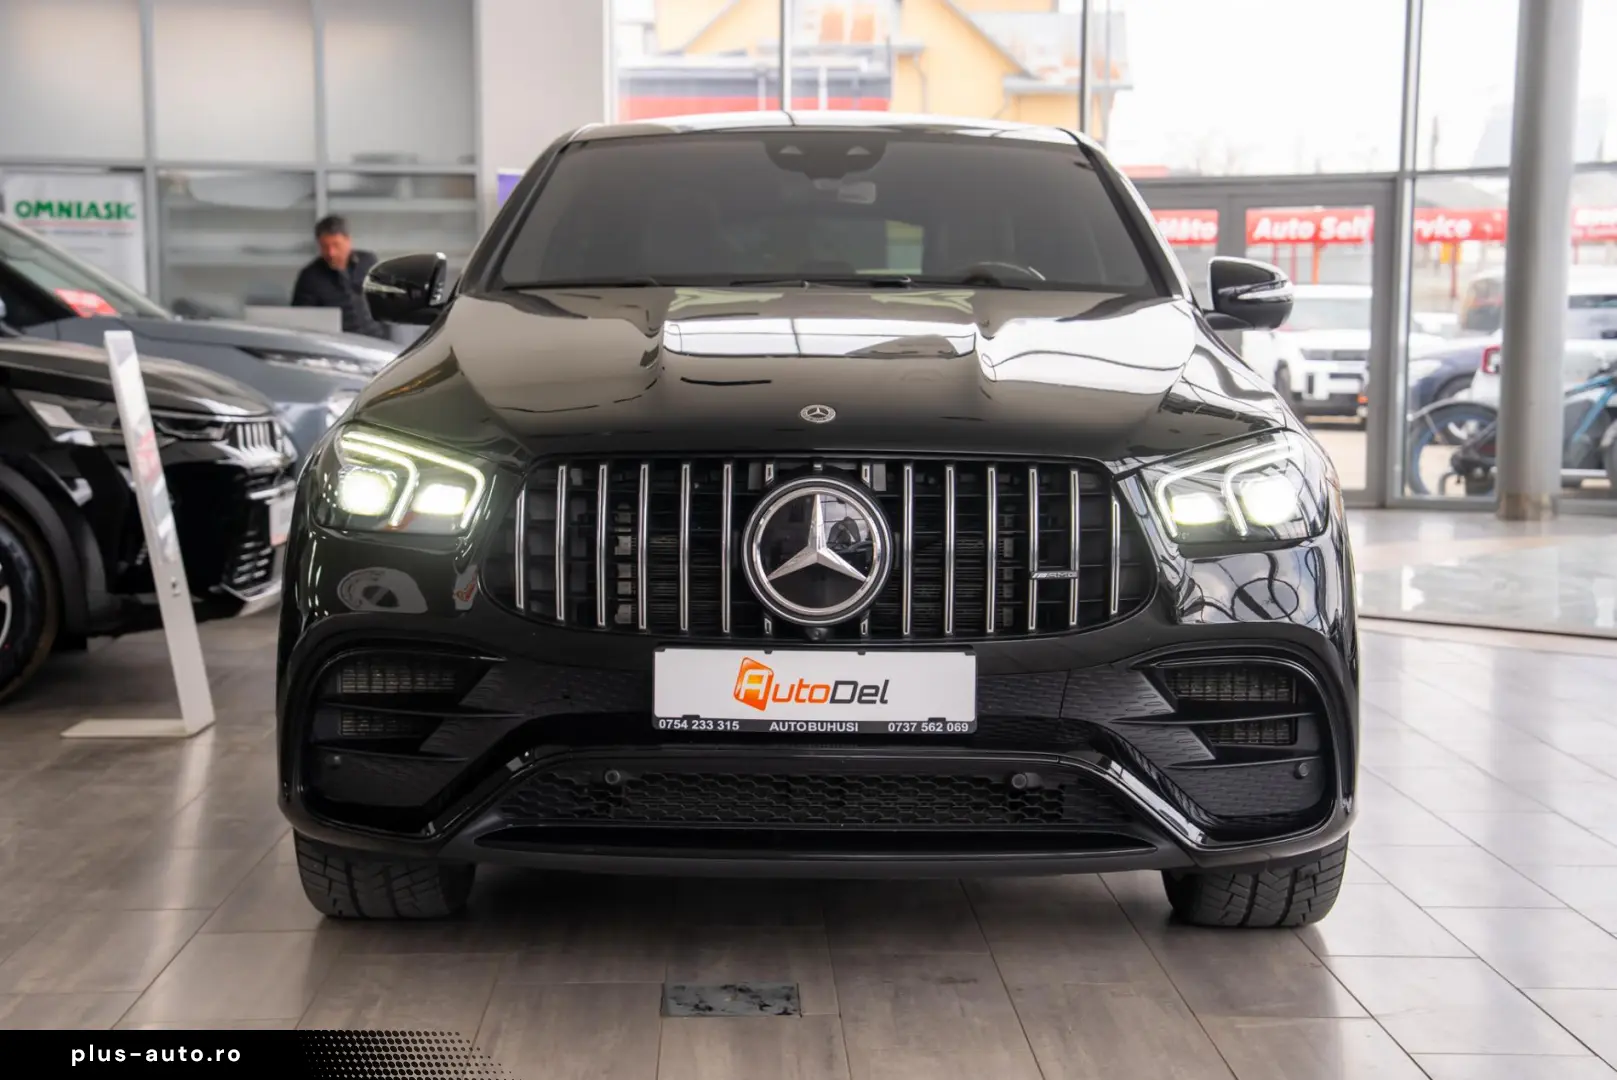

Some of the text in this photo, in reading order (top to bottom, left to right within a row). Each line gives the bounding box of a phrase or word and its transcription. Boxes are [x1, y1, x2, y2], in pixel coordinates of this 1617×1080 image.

[1252, 217, 1316, 240] Auto
[737, 666, 890, 705] AutoDel
[658, 718, 740, 731] 0754 233 315
[769, 721, 859, 732] AUTOBUHUSI
[887, 722, 969, 732] 0737 562 069
